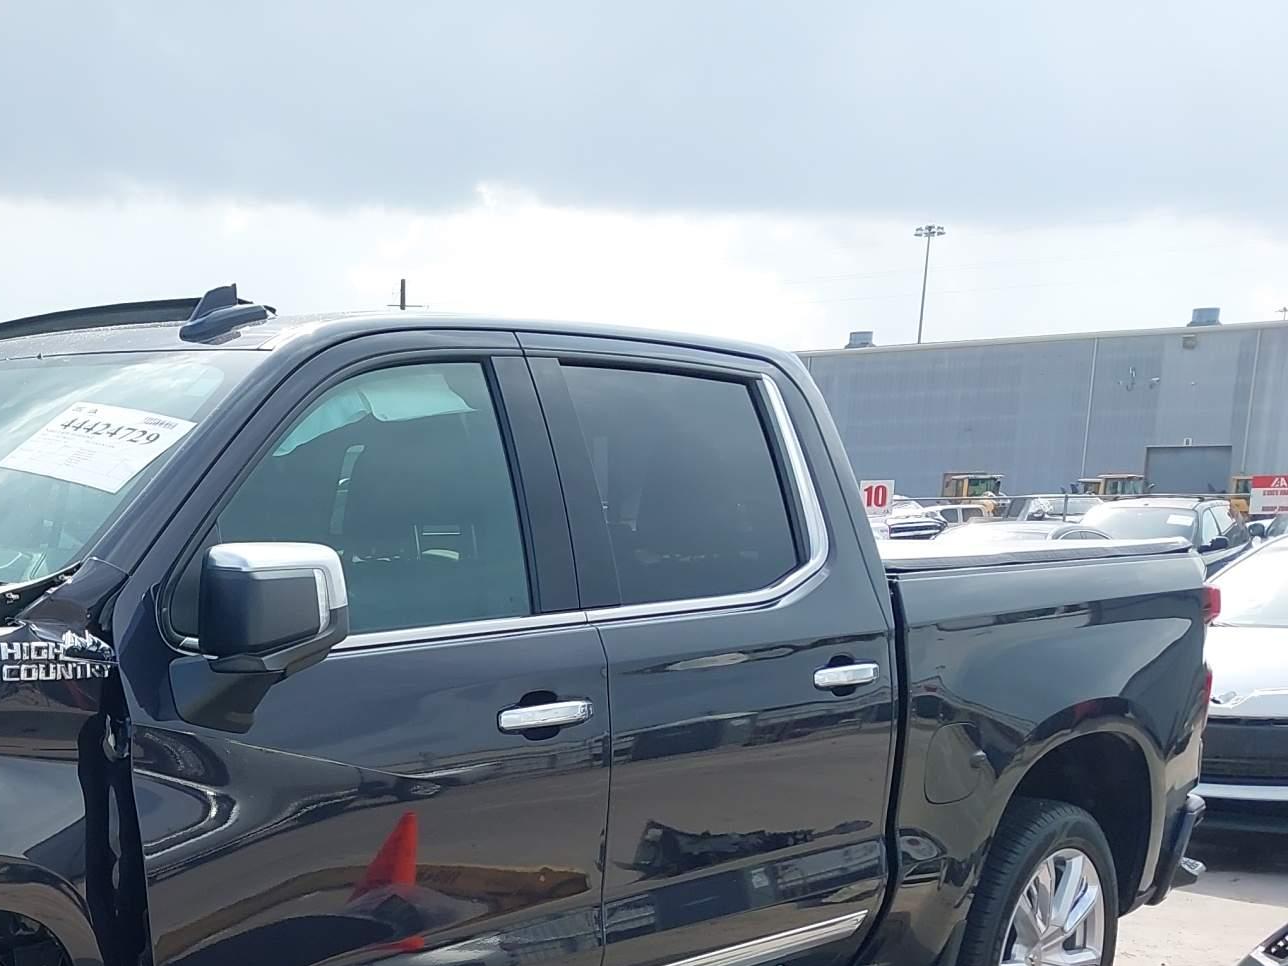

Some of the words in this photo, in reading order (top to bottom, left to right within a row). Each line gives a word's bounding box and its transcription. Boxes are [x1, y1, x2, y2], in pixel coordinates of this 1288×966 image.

[60, 418, 161, 445] 44424729
[863, 484, 887, 508] 10
[1, 662, 112, 682] COUNTRY
